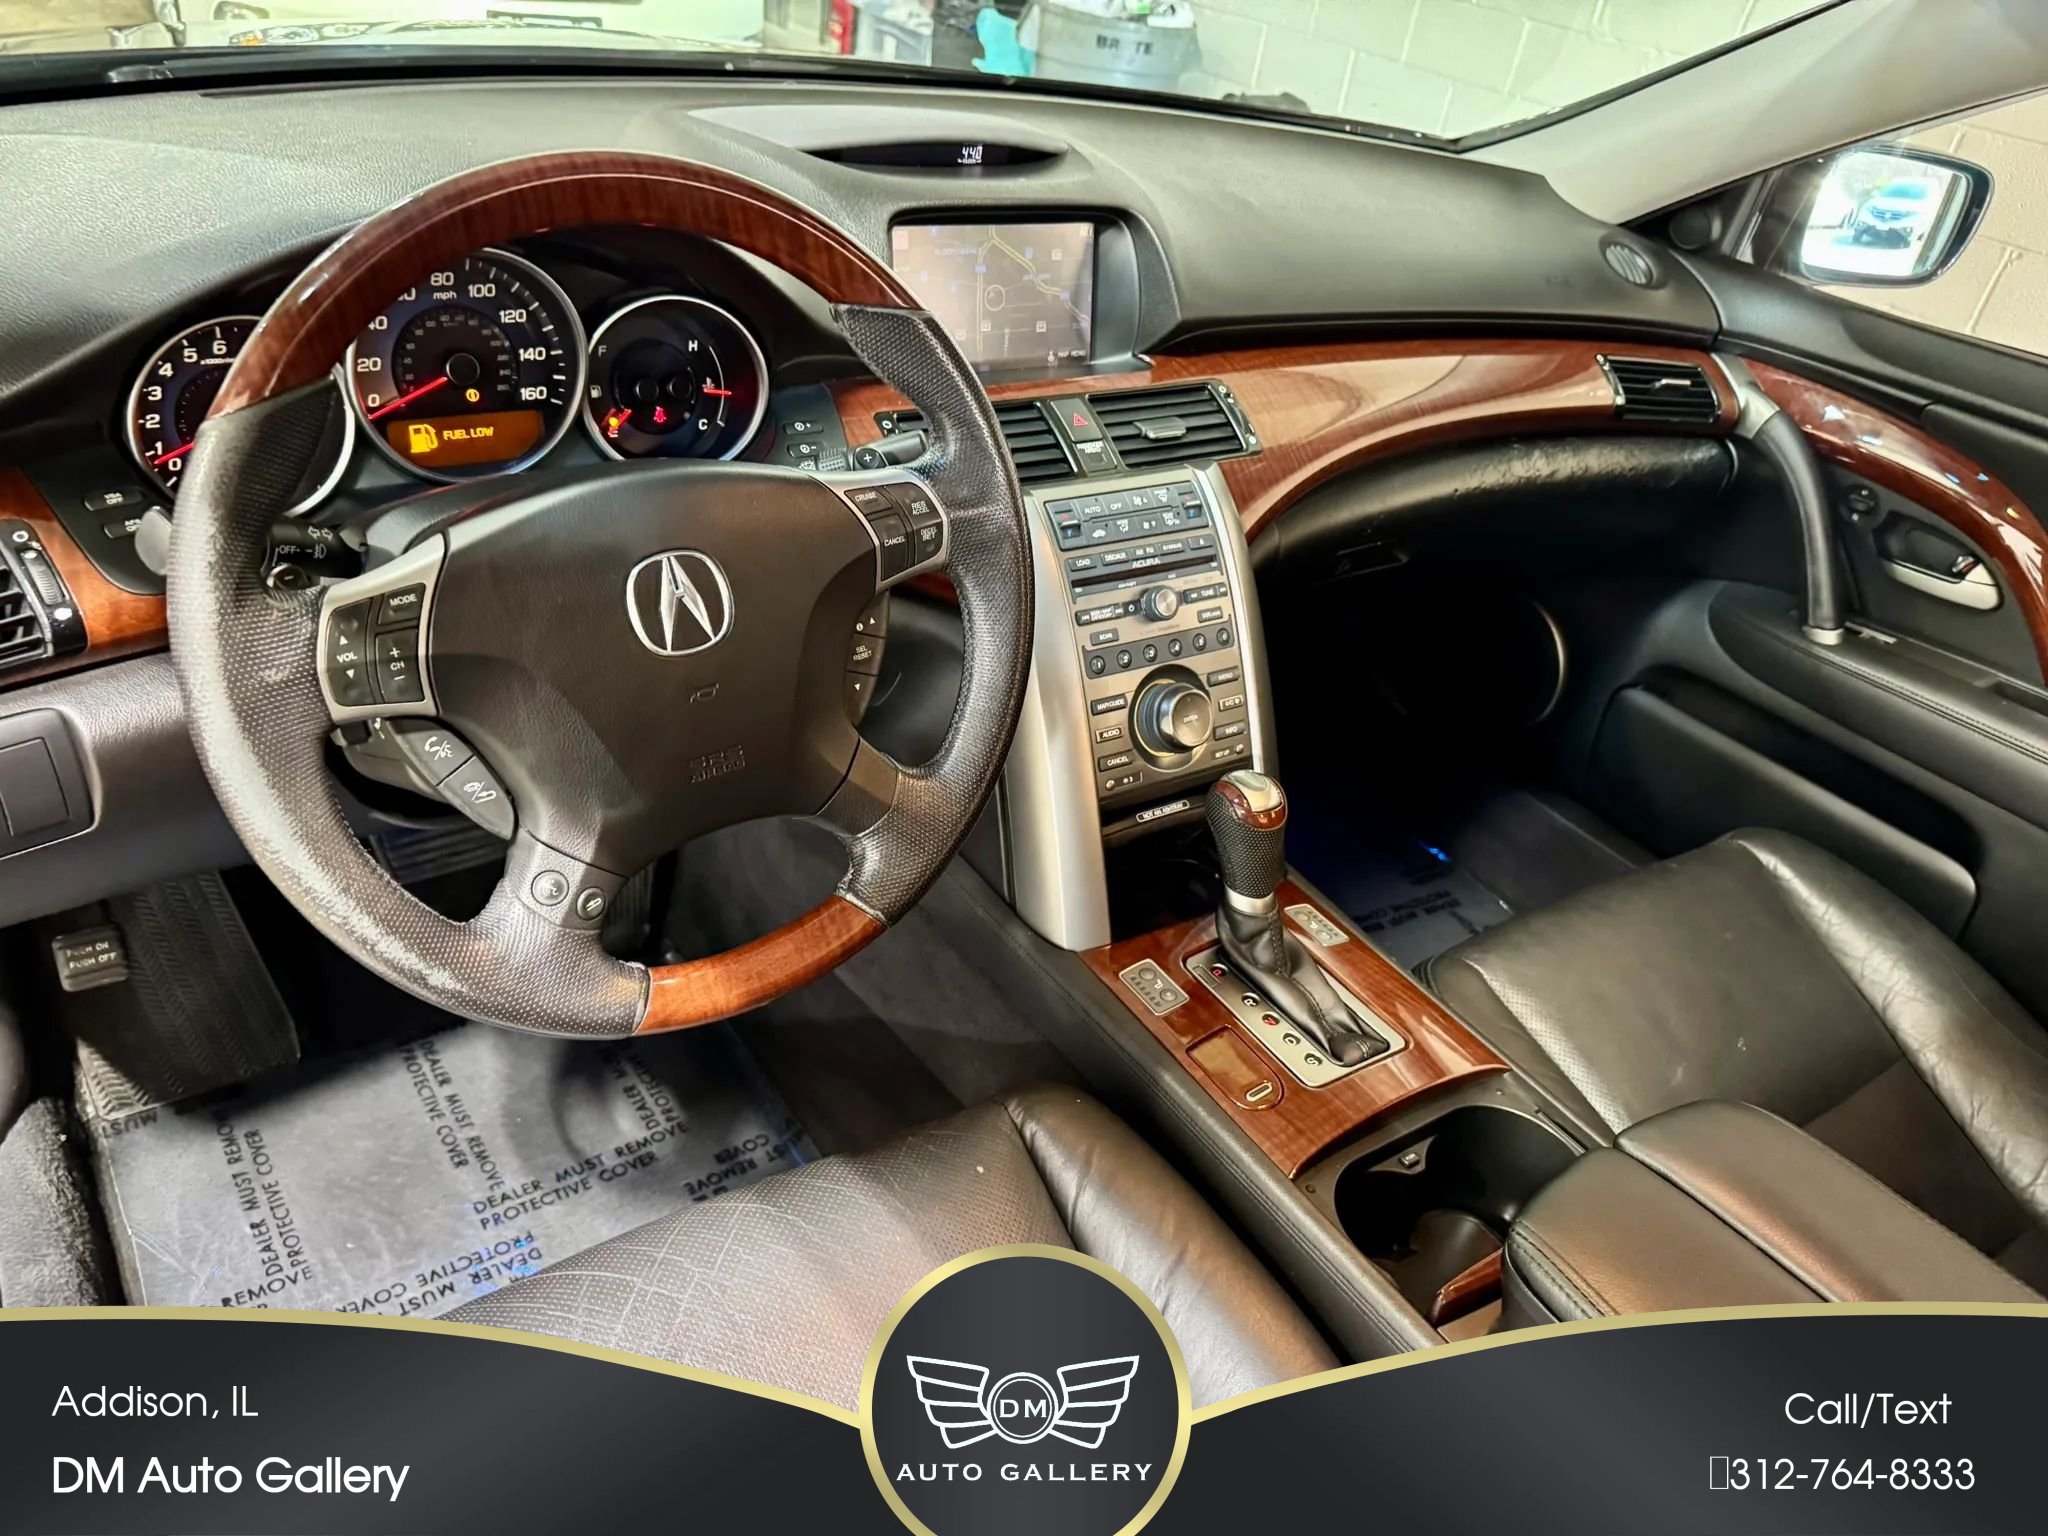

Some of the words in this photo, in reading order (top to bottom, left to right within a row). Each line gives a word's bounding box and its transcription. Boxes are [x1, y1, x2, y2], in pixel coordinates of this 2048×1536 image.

[430, 272, 454, 286] 80
[433, 290, 457, 300] mph
[468, 284, 496, 298] 100
[499, 309, 527, 324] 120
[212, 340, 227, 355] 6
[598, 345, 607, 357] F
[688, 340, 698, 352] H
[183, 348, 198, 363] 5
[519, 347, 546, 361] 140
[158, 363, 174, 377] 4
[357, 357, 381, 372] 20
[147, 386, 162, 401] 3
[520, 386, 547, 401] 160
[368, 394, 380, 408] 0
[145, 414, 161, 429] 2
[698, 419, 708, 431] C
[443, 429, 470, 441] FUEL
[471, 426, 494, 438] LOW
[154, 441, 163, 456] 1
[168, 458, 182, 472] 0
[855, 491, 877, 502] CRUISE
[911, 501, 927, 510] RES
[912, 507, 930, 516] ACCEL
[1084, 506, 1101, 515] AUTO
[1110, 502, 1122, 511] OFF
[884, 536, 906, 547] CANCEL
[280, 545, 296, 554] OFF
[1076, 558, 1091, 568] LOAD
[1132, 557, 1160, 568] ACURA
[390, 593, 418, 607] MODE
[337, 651, 357, 663] VOL
[853, 650, 872, 661] RESET
[390, 661, 405, 671] CH
[1102, 727, 1121, 738] AUDIO
[1224, 726, 1238, 735] INFO
[1107, 755, 1129, 768] CANCEL
[96, 941, 109, 951] ON
[98, 952, 117, 963] OFF
[1243, 998, 1256, 1008] R
[1305, 1057, 1320, 1067] S
[623, 1083, 660, 1131] DEALER
[421, 1039, 453, 1088] DEALER
[445, 1093, 475, 1130] MUST
[467, 1135, 505, 1192] REMOVE
[102, 1110, 158, 1139] MUST
[243, 1129, 272, 1176] COVER
[436, 1125, 470, 1169] COVER
[714, 1133, 770, 1164] COVER
[472, 1179, 544, 1215] DEALER
[555, 1153, 606, 1184] MUST
[614, 1121, 688, 1158] REMOVE
[683, 1158, 758, 1196] REMOVE
[232, 1171, 260, 1212] MUST
[480, 1177, 593, 1231] PROTECTIVE
[599, 1151, 659, 1183] COVER
[262, 1180, 304, 1268] PROTECTIVE
[250, 1218, 283, 1277] DEALER
[415, 1230, 535, 1288] PROTECTIVE
[469, 1247, 544, 1285] DEALER
[221, 1265, 313, 1307] REMOVE
[400, 1282, 456, 1317] MUST
